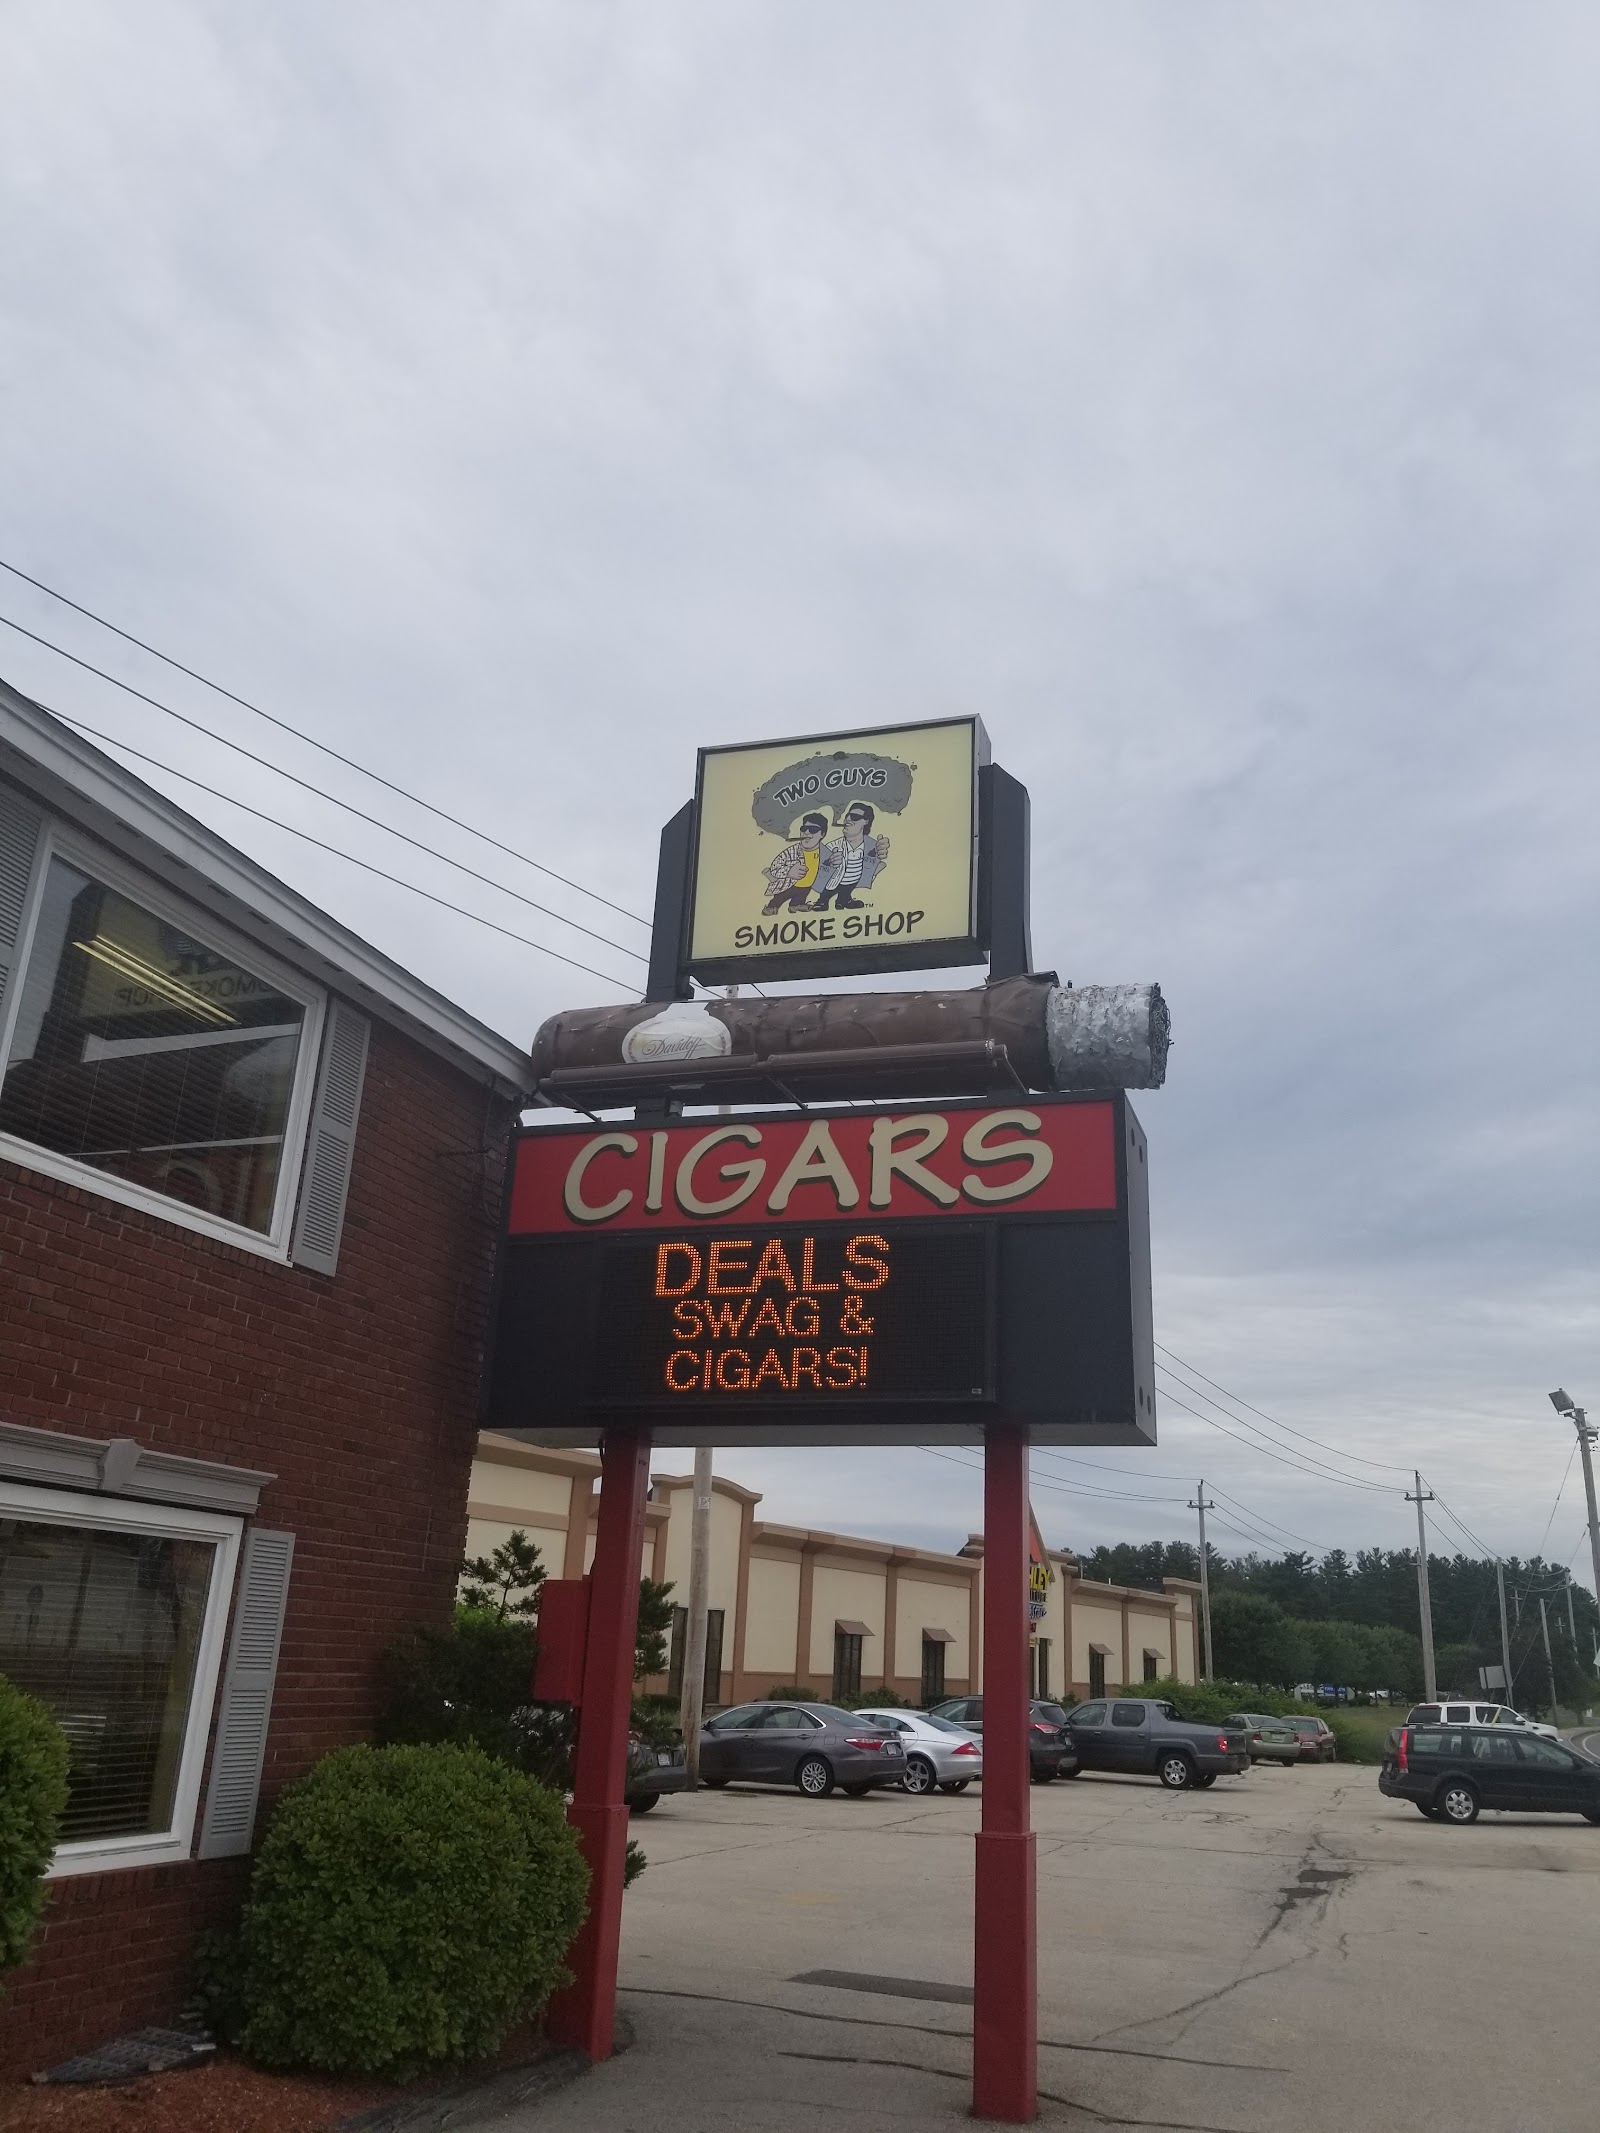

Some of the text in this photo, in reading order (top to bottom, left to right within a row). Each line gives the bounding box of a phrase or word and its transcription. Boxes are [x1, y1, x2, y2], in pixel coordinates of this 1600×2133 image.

[773, 767, 887, 807] TWO GUYS
[734, 910, 925, 949] SMOKE SHOP
[642, 1035, 706, 1060] Davidoff
[564, 1109, 1055, 1223] CIGARS
[655, 1234, 889, 1297] DEALS
[673, 1295, 874, 1339] SWAG &
[665, 1346, 868, 1391] CIGARS!
